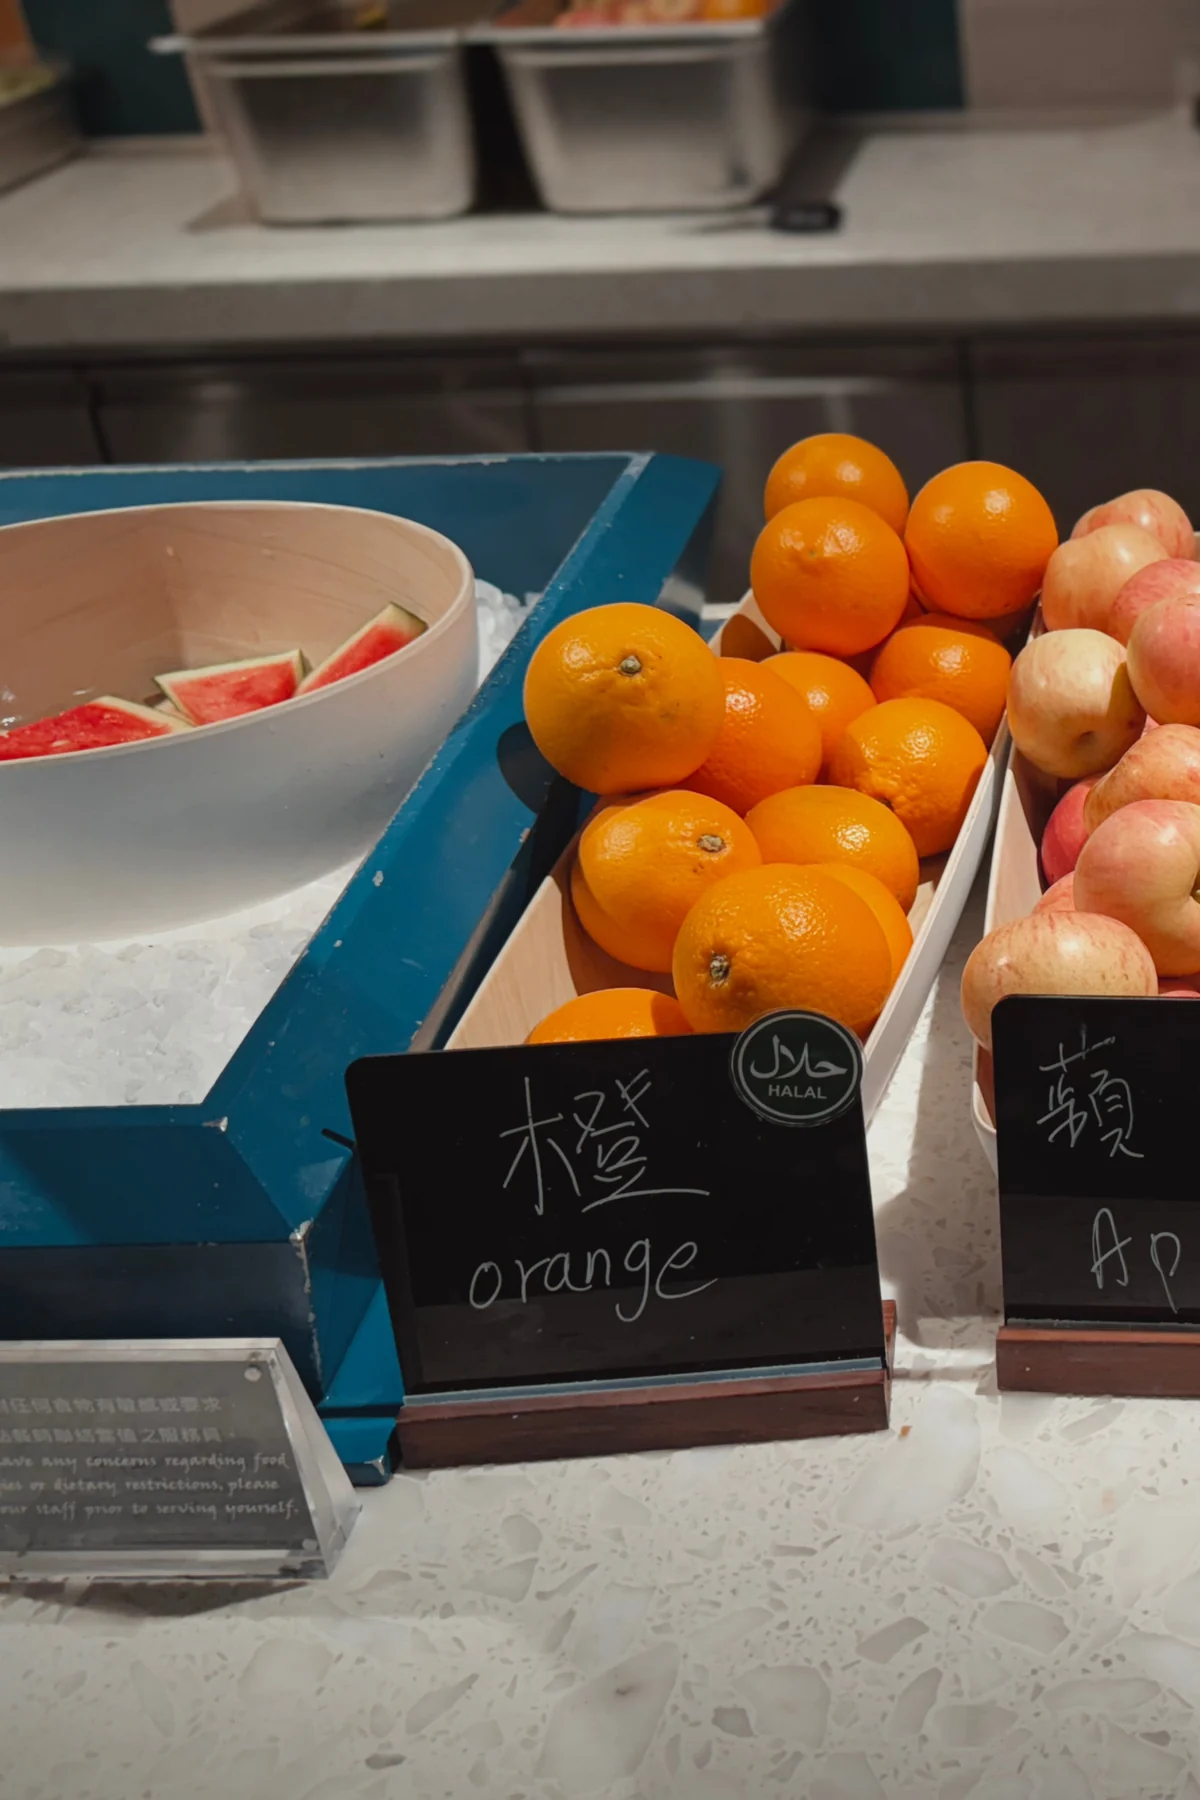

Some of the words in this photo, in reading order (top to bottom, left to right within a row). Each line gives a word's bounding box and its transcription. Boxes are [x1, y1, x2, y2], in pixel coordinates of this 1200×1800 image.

[749, 1034, 848, 1079] حلال
[767, 1084, 827, 1100] HALAL
[499, 1068, 710, 1215] 橙
[469, 1237, 719, 1322] orange
[0, 1456, 34, 1468] ave
[41, 1456, 77, 1475] any
[86, 1456, 157, 1468] concerns
[164, 1452, 246, 1474] regarding
[253, 1451, 290, 1474] food
[29, 1481, 46, 1491] or
[53, 1478, 117, 1498] dietary
[227, 1477, 280, 1497] please
[36, 1499, 77, 1522] staff
[83, 1504, 123, 1522] prior
[132, 1502, 148, 1515] to
[156, 1501, 218, 1521] serving
[224, 1497, 300, 1521] yourself.
